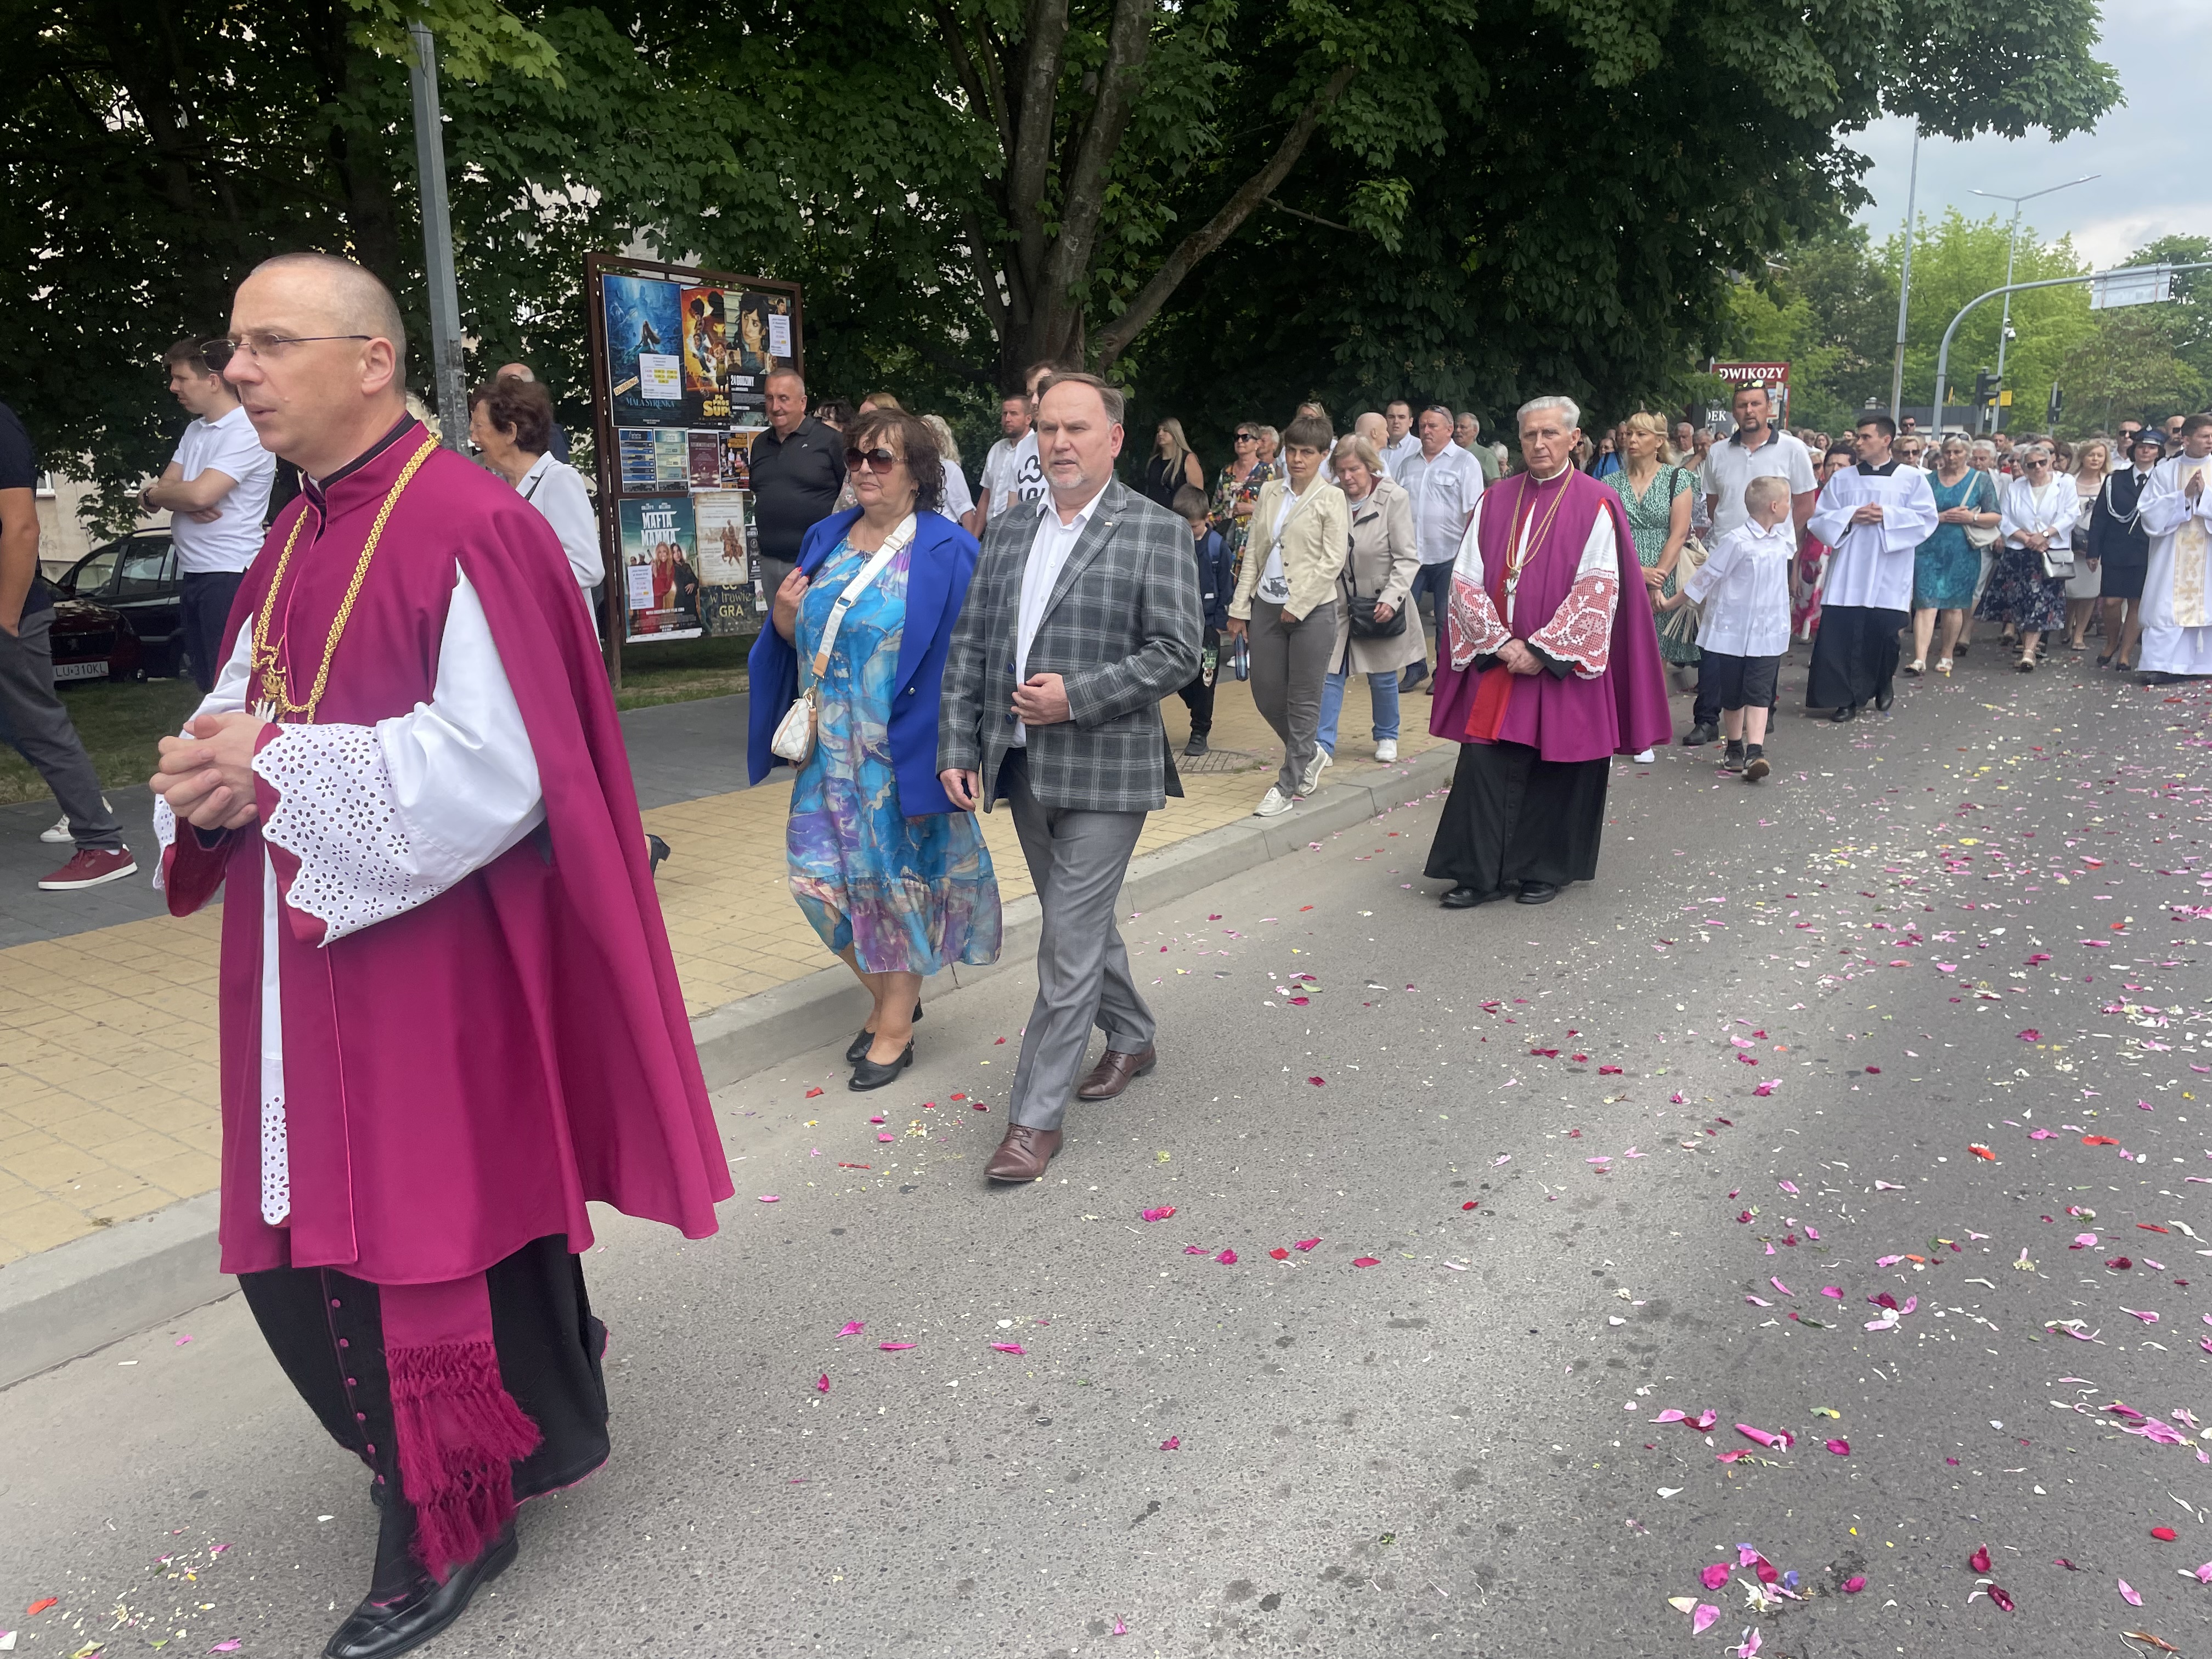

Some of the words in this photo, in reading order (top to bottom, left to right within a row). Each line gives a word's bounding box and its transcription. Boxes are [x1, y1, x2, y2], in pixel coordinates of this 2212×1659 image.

[1719, 367, 1785, 380] DWIKOZY
[614, 377, 639, 395] DUBBING
[703, 400, 730, 417] SUP
[641, 511, 677, 529] MAFIA
[641, 527, 681, 546] MAMMA
[719, 605, 744, 617] GRA
[55, 665, 70, 677] LU
[74, 663, 107, 675] 310KL
